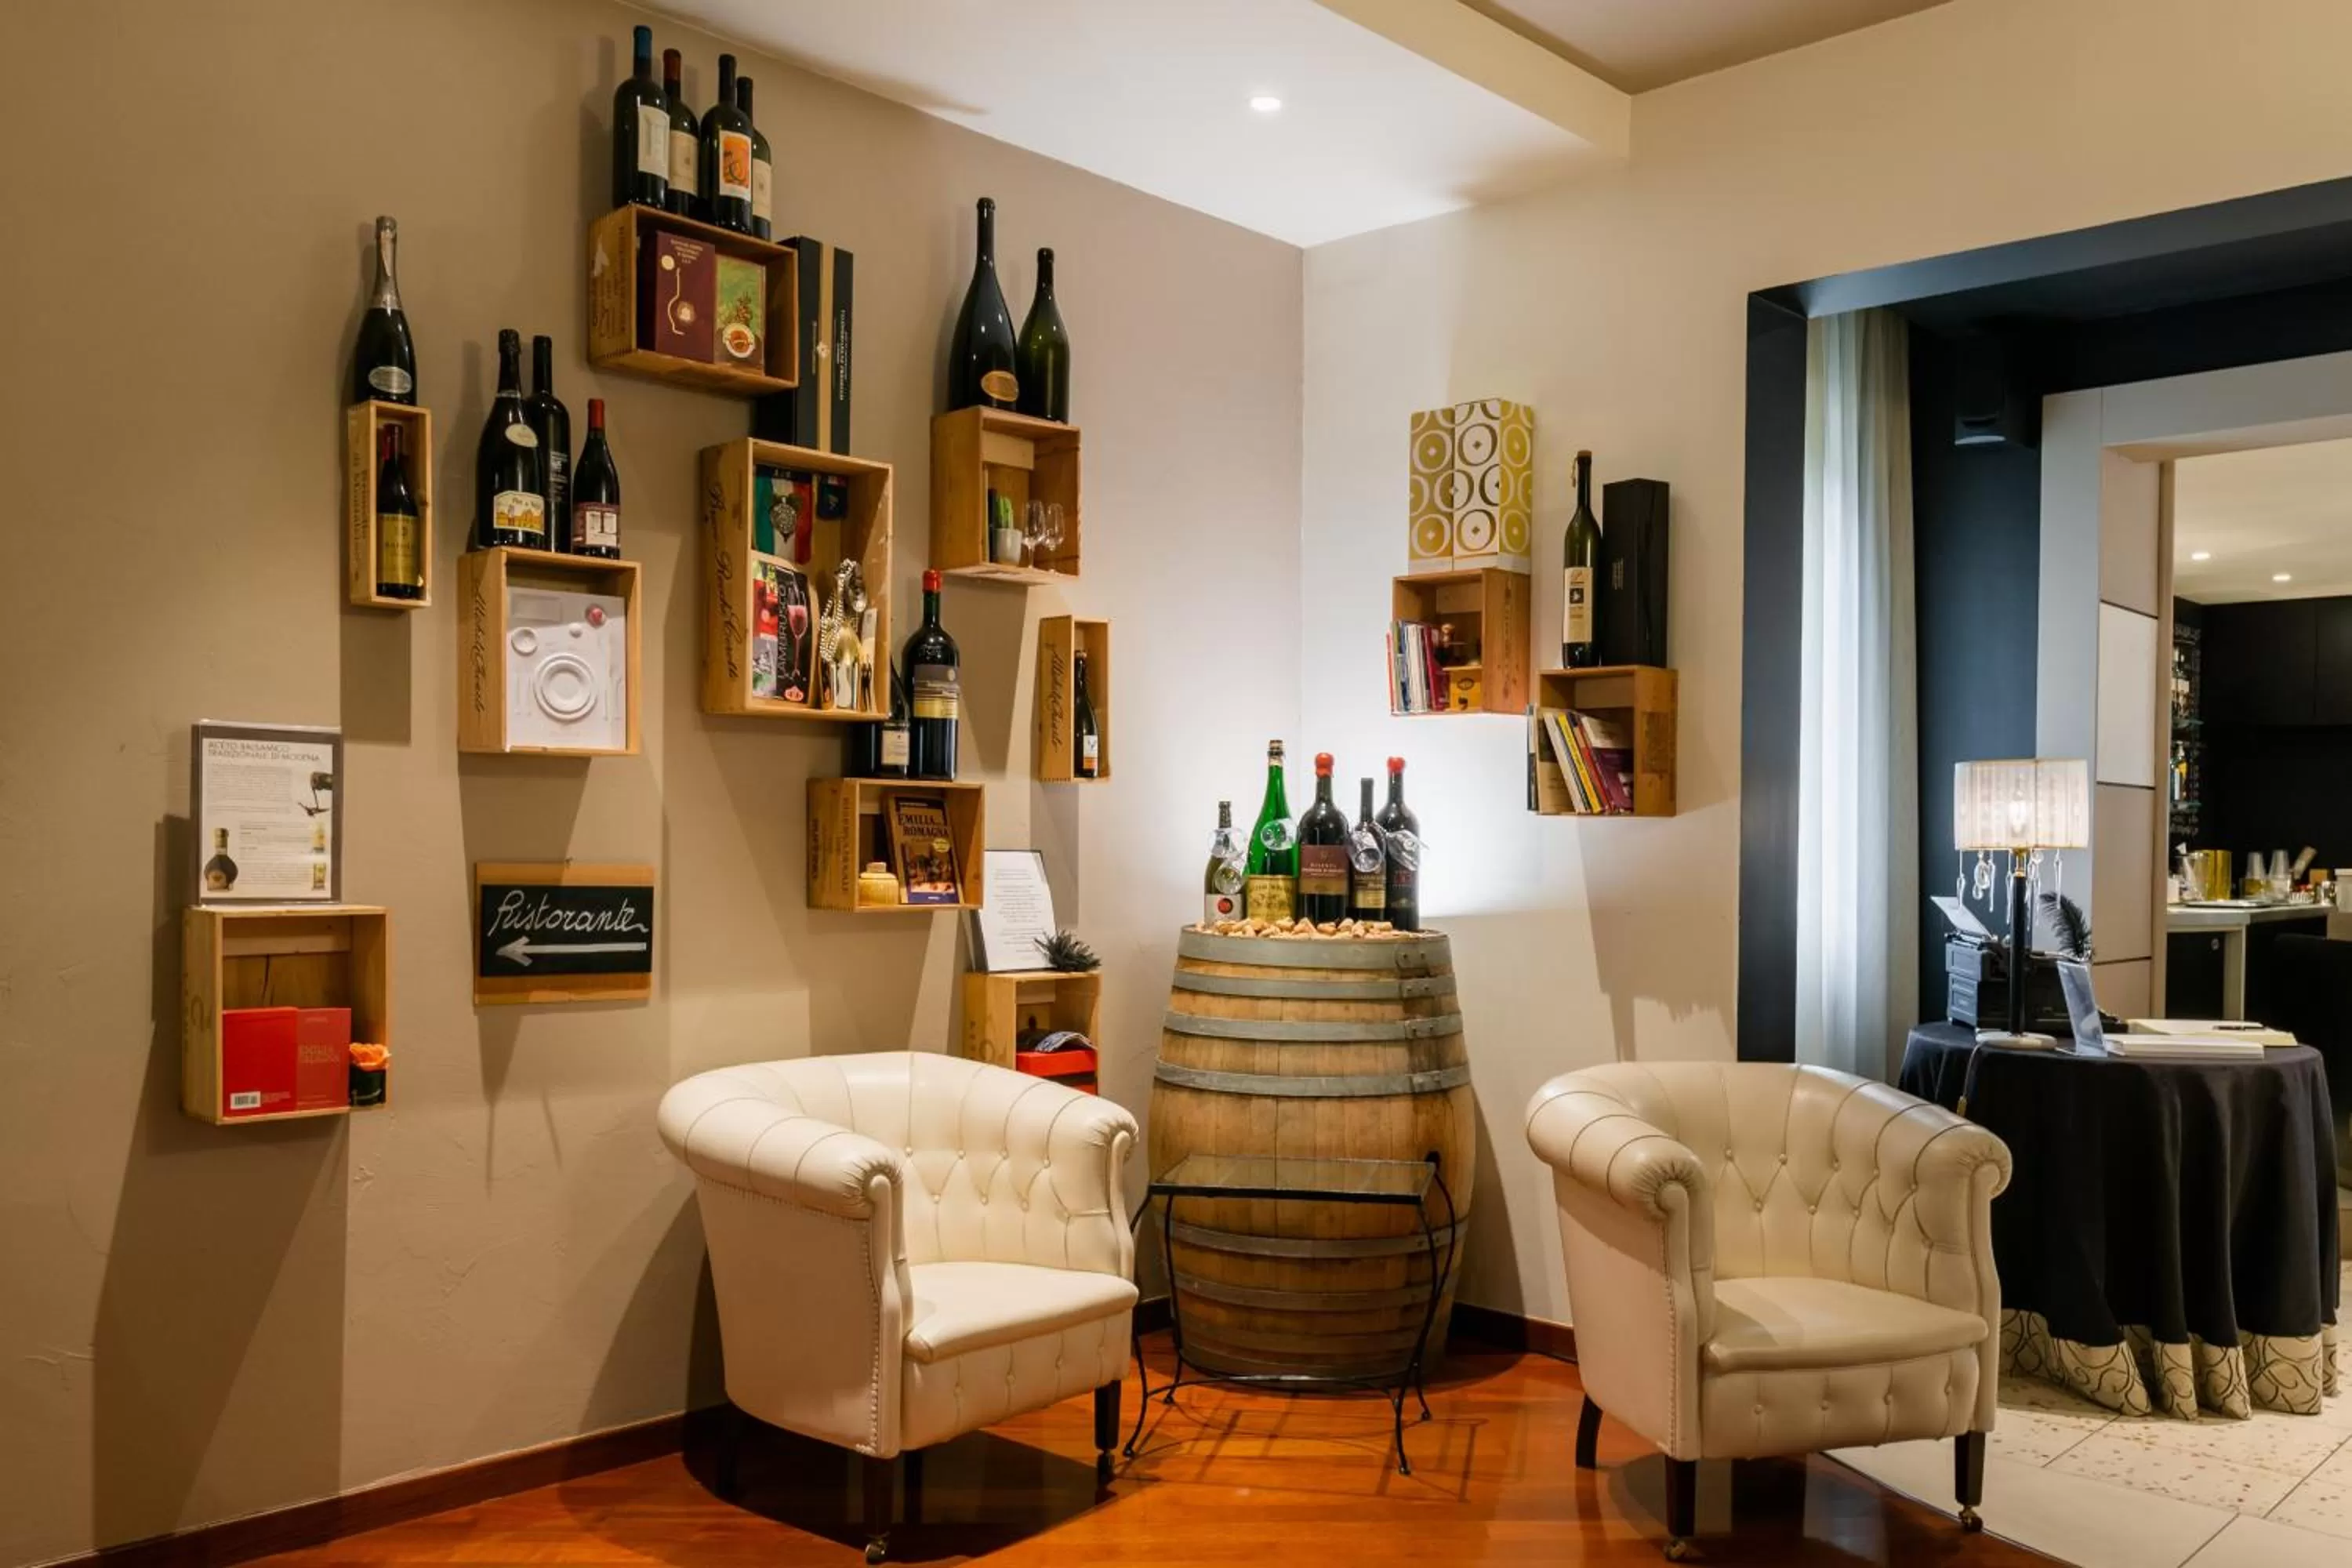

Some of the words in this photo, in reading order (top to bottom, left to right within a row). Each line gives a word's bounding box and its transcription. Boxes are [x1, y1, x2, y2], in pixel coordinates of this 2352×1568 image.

[778, 585, 787, 679] LAMBRUSCO
[898, 815, 935, 826] EMILIA
[902, 826, 949, 837] ROMAGNA
[487, 890, 649, 937] Ristorante
